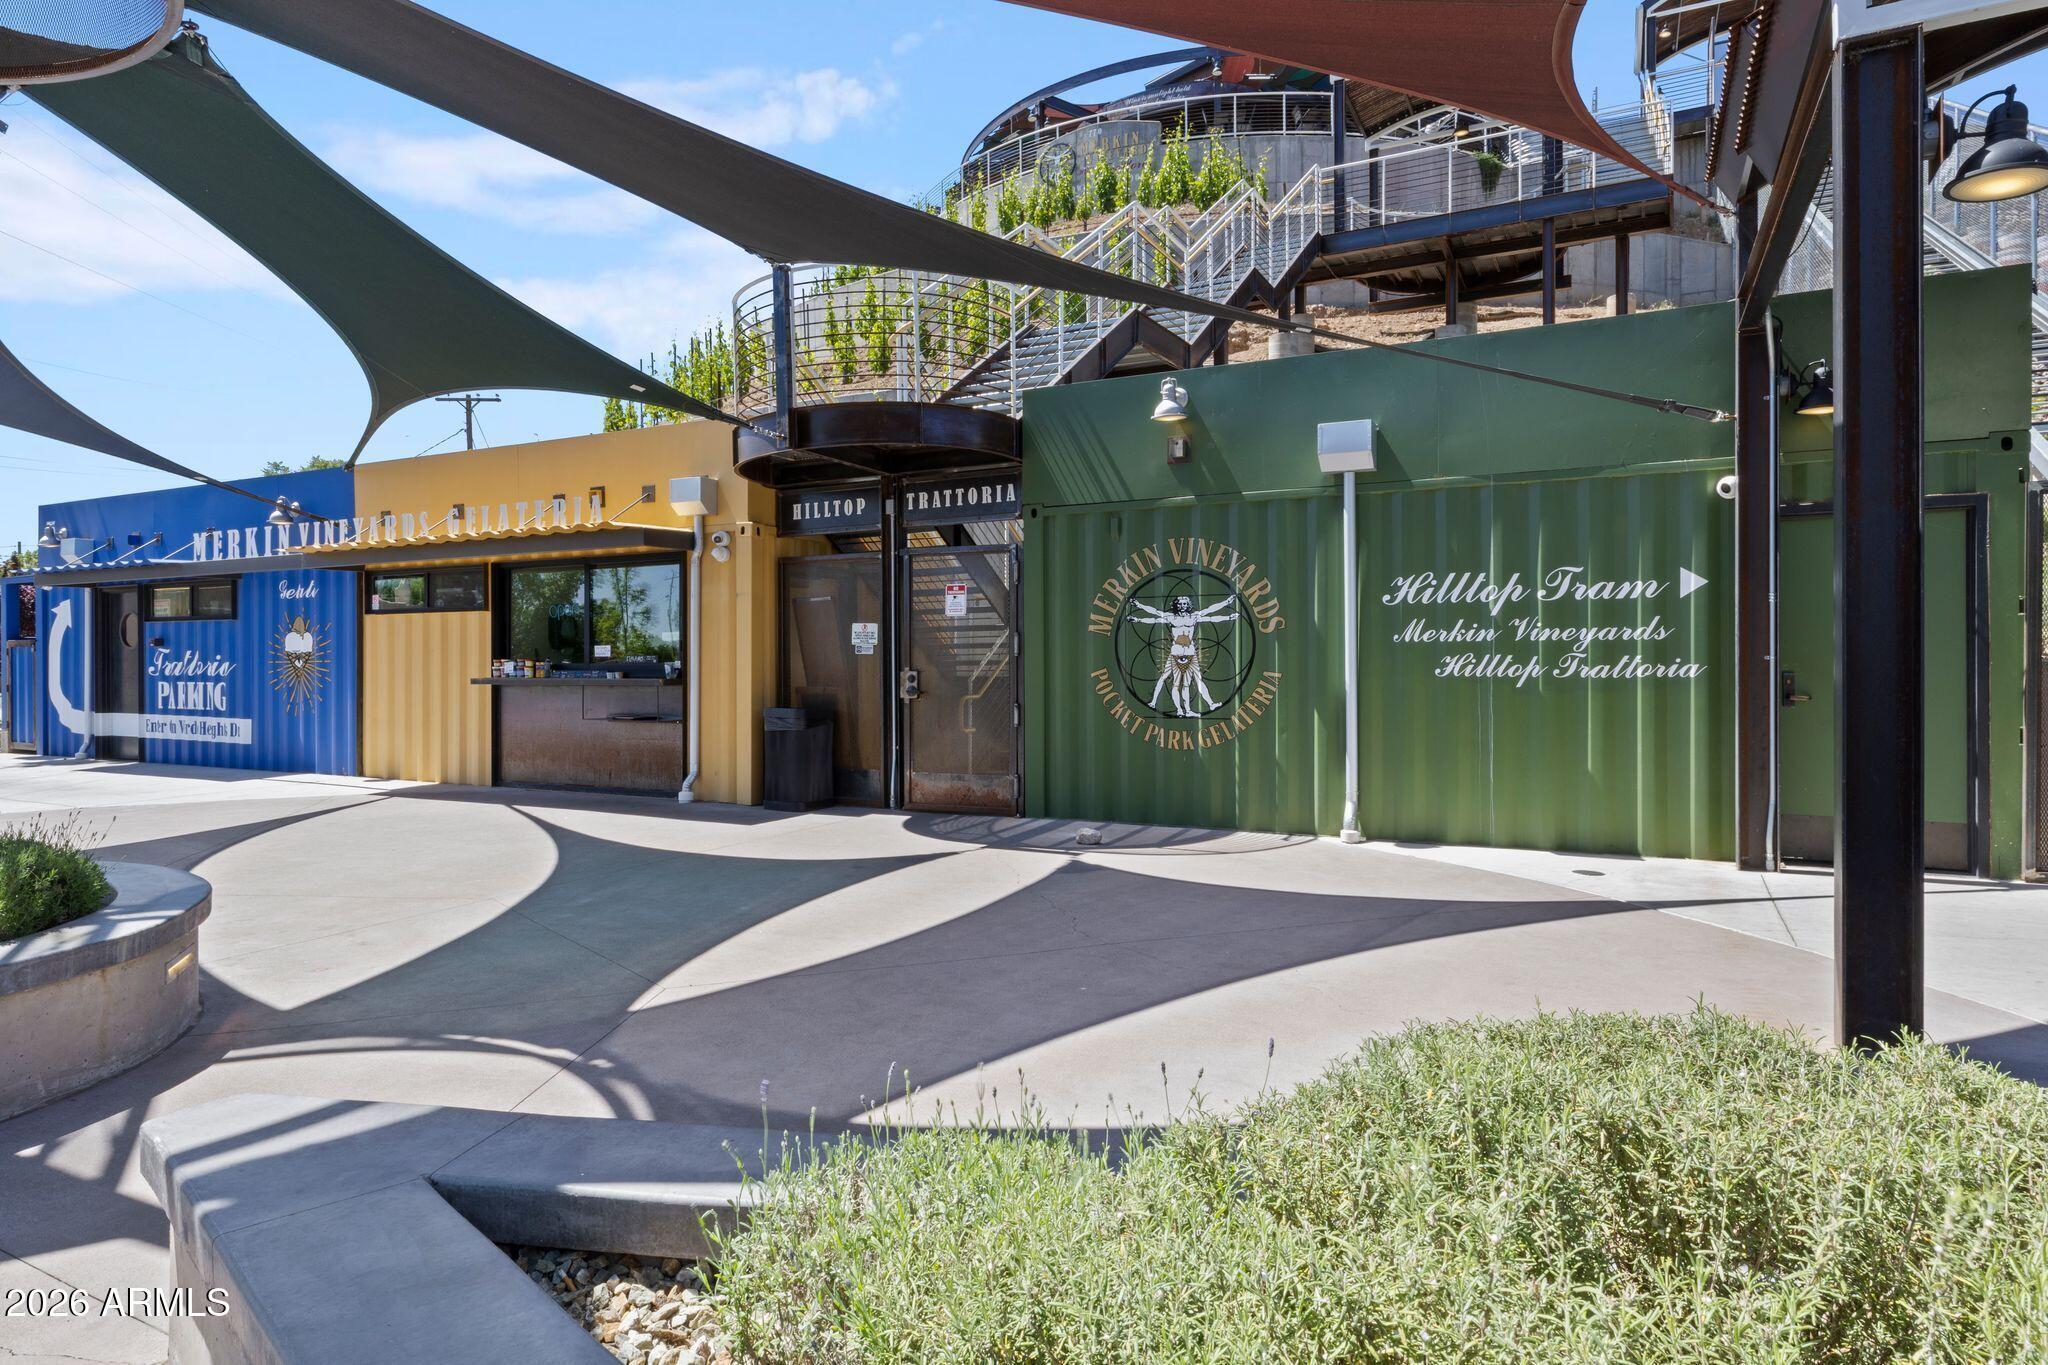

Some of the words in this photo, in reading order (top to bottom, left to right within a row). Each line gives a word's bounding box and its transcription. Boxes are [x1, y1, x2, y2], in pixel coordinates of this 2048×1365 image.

[792, 498, 866, 520] HILLTOP
[906, 484, 1016, 510] TRATTORIA
[193, 523, 291, 561] MERKIN
[299, 511, 429, 548] VINEYARDS
[448, 494, 603, 537] GELATERIA
[1088, 543, 1162, 636] MERKIN
[1168, 537, 1286, 634] VINEYARDS
[1382, 571, 1531, 616] Hilltop
[1537, 566, 1670, 601] Tram
[1393, 618, 1502, 642] Merkin
[1508, 616, 1675, 652] Vineyards
[1434, 652, 1549, 687] Hilltop
[1553, 652, 1708, 679] Trattoria
[158, 681, 226, 711] PARKING
[1090, 666, 1146, 735] POCKET
[1144, 722, 1195, 750] PARK
[1199, 669, 1283, 748] GELATERIA
